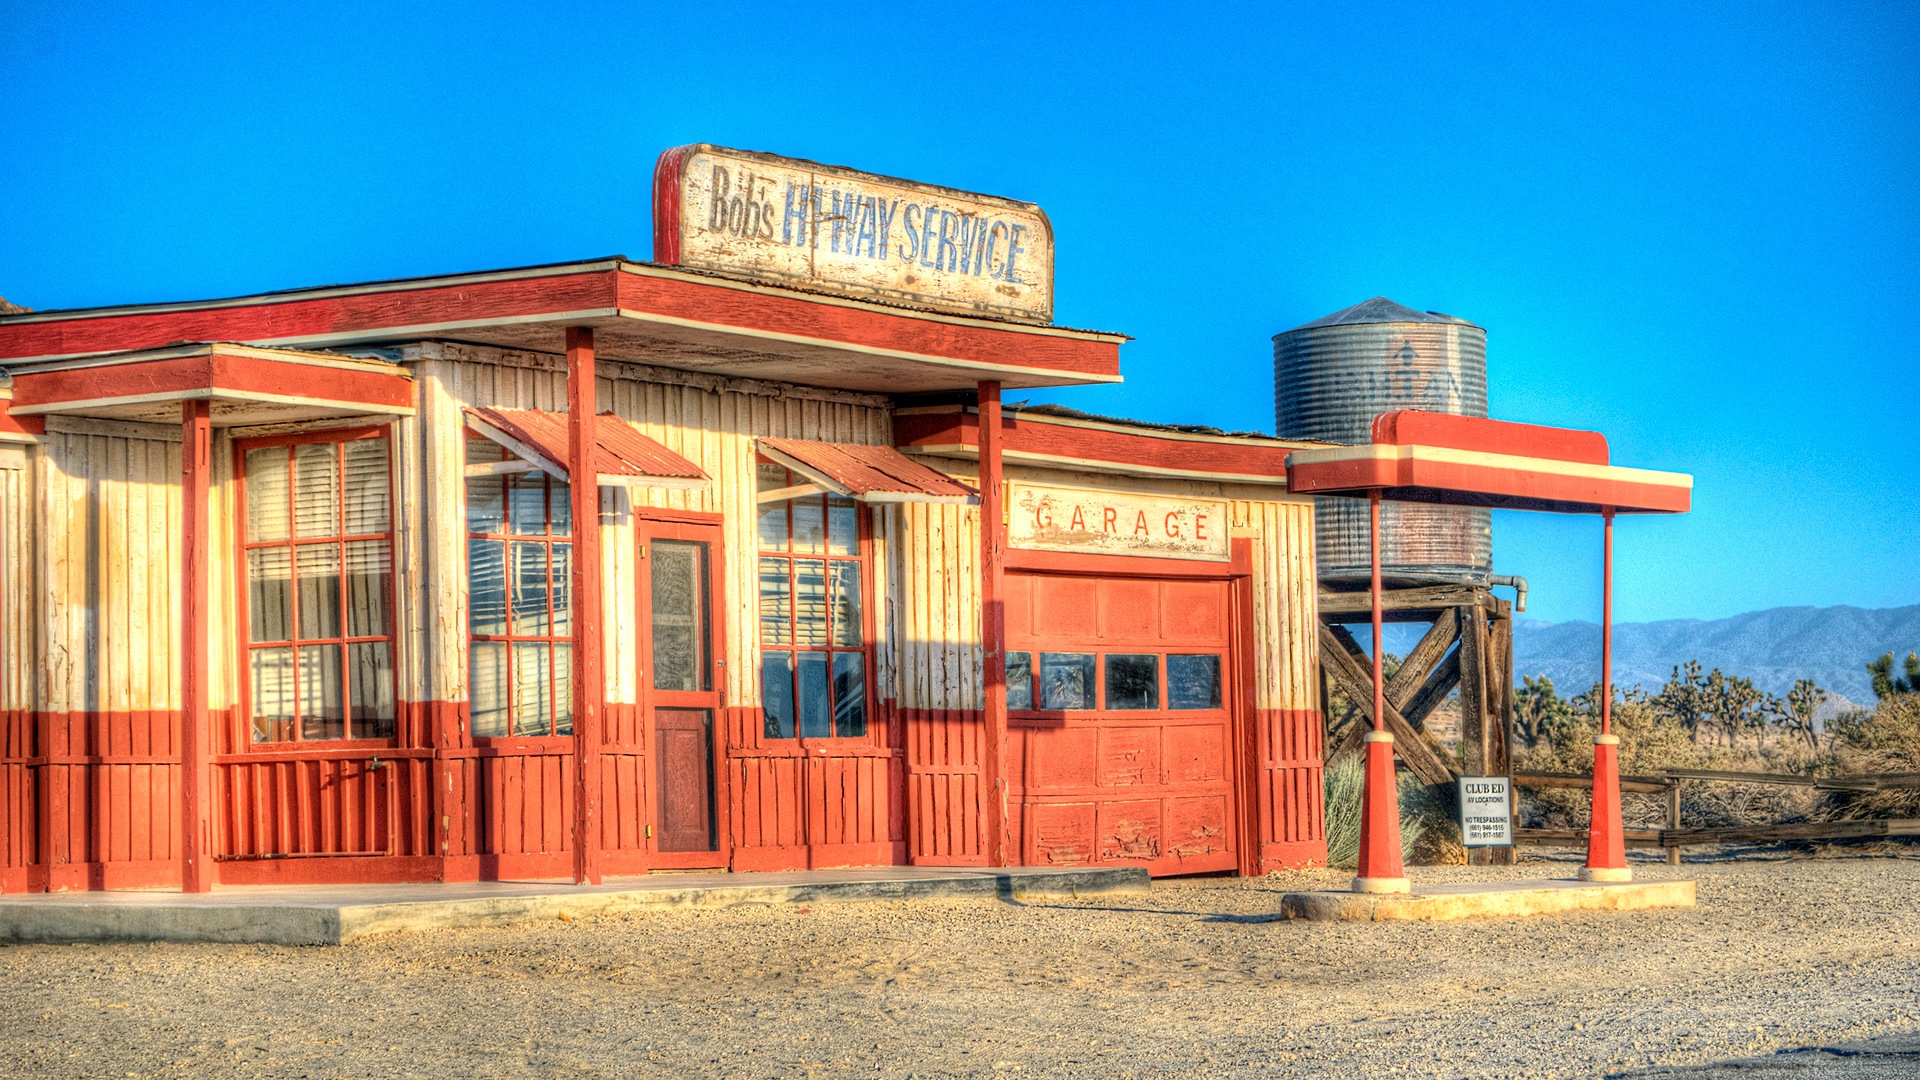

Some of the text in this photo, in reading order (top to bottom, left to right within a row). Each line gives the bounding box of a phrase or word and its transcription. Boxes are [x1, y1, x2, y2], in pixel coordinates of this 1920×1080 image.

[709, 165, 775, 239] Bob's
[899, 204, 1027, 283] SERVICE
[1036, 502, 1208, 540] GARAGE
[1465, 784, 1504, 793] CLUB ED
